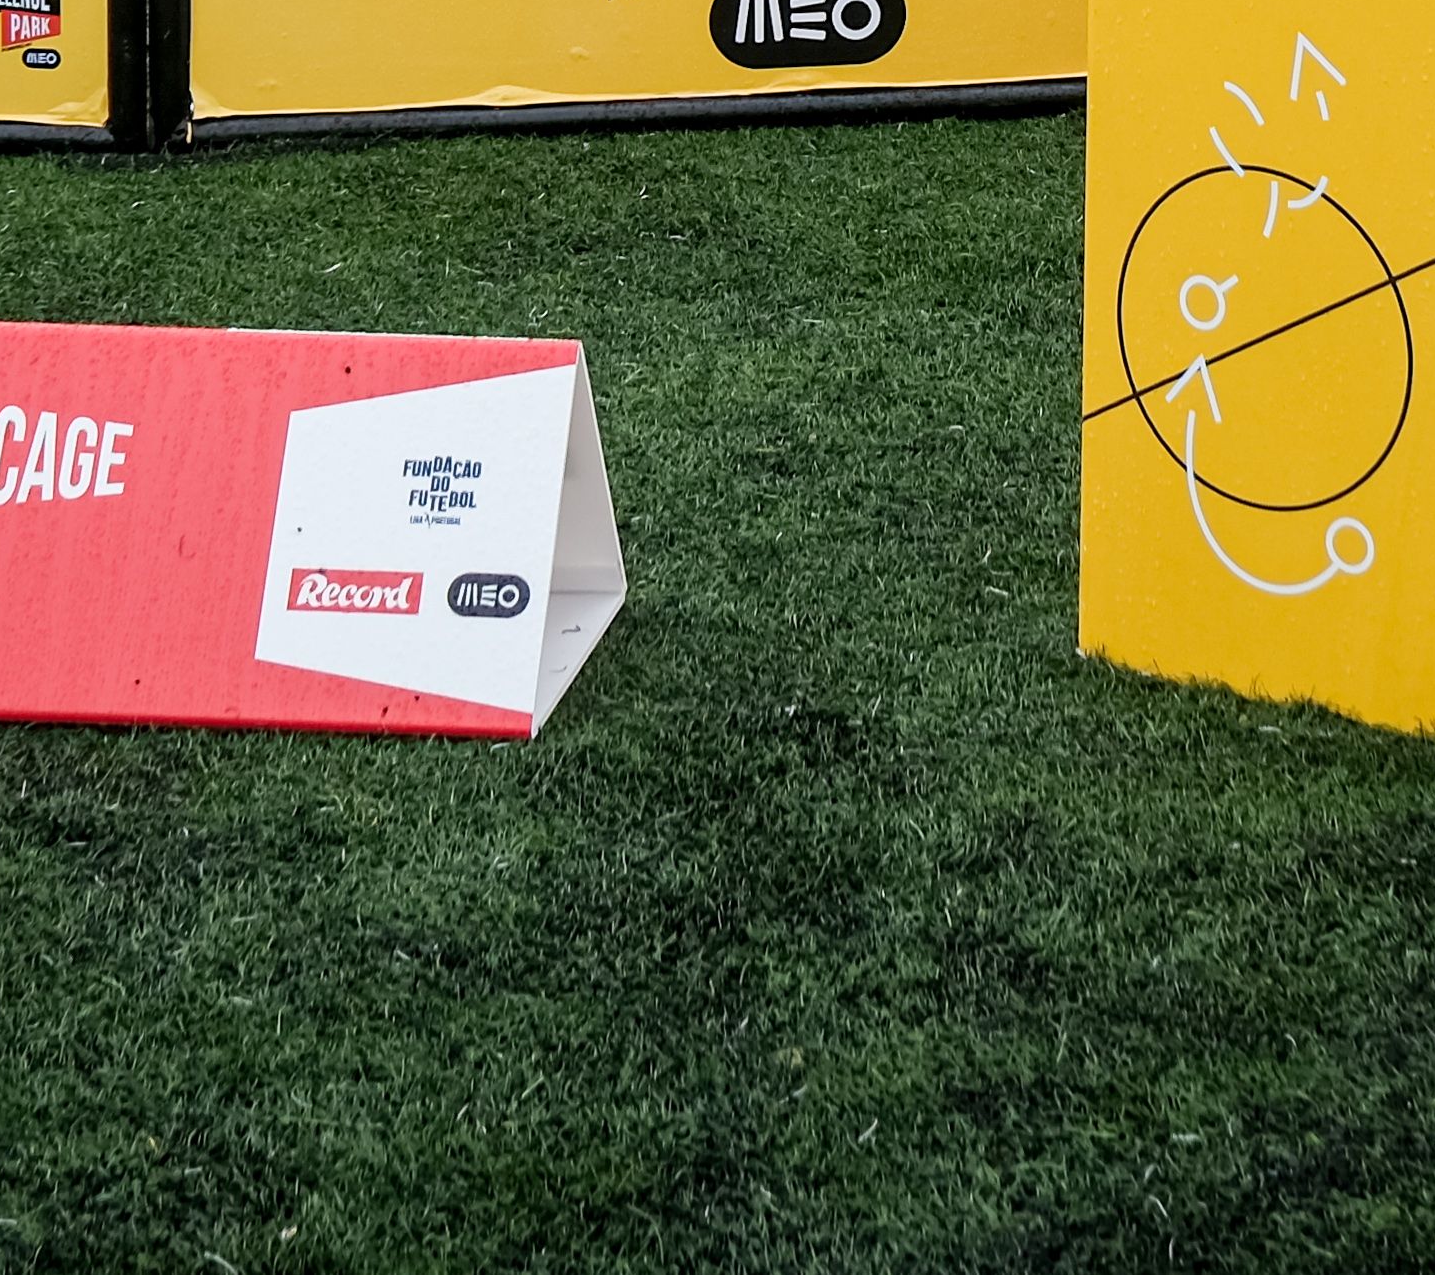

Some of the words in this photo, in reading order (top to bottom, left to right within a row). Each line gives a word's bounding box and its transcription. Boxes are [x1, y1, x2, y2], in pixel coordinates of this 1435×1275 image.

[10, 13, 50, 42] PARK
[26, 52, 57, 65] MEO
[430, 475, 451, 492] DO
[408, 489, 477, 512] FUTEBOL
[296, 573, 414, 610] Record
[456, 583, 520, 608] MEO
